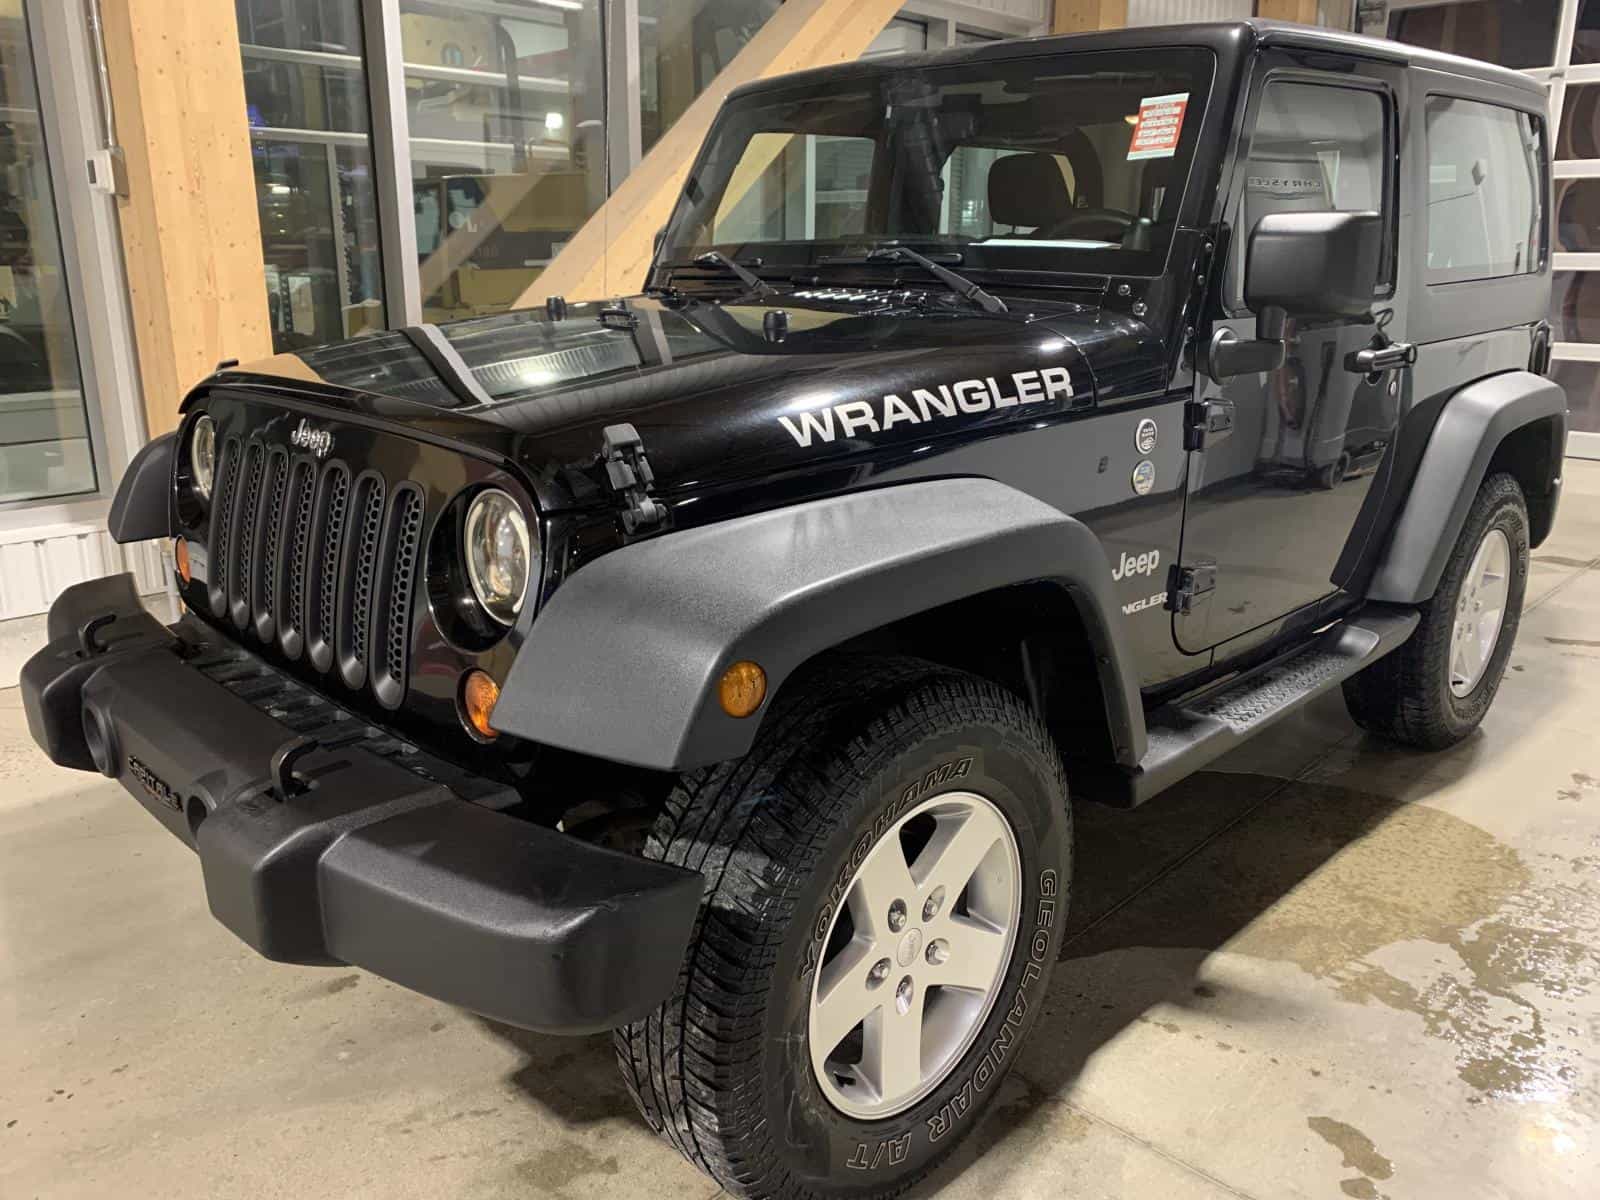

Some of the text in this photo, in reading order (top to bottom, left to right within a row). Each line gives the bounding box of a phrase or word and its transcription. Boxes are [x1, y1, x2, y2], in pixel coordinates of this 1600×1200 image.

[291, 417, 334, 458] Jeep
[777, 366, 1074, 449] WRANGLER
[1111, 549, 1160, 581] Jeep
[800, 756, 975, 978] YOKOHAMA
[846, 868, 1057, 1170] GEOLANDAR A/T
